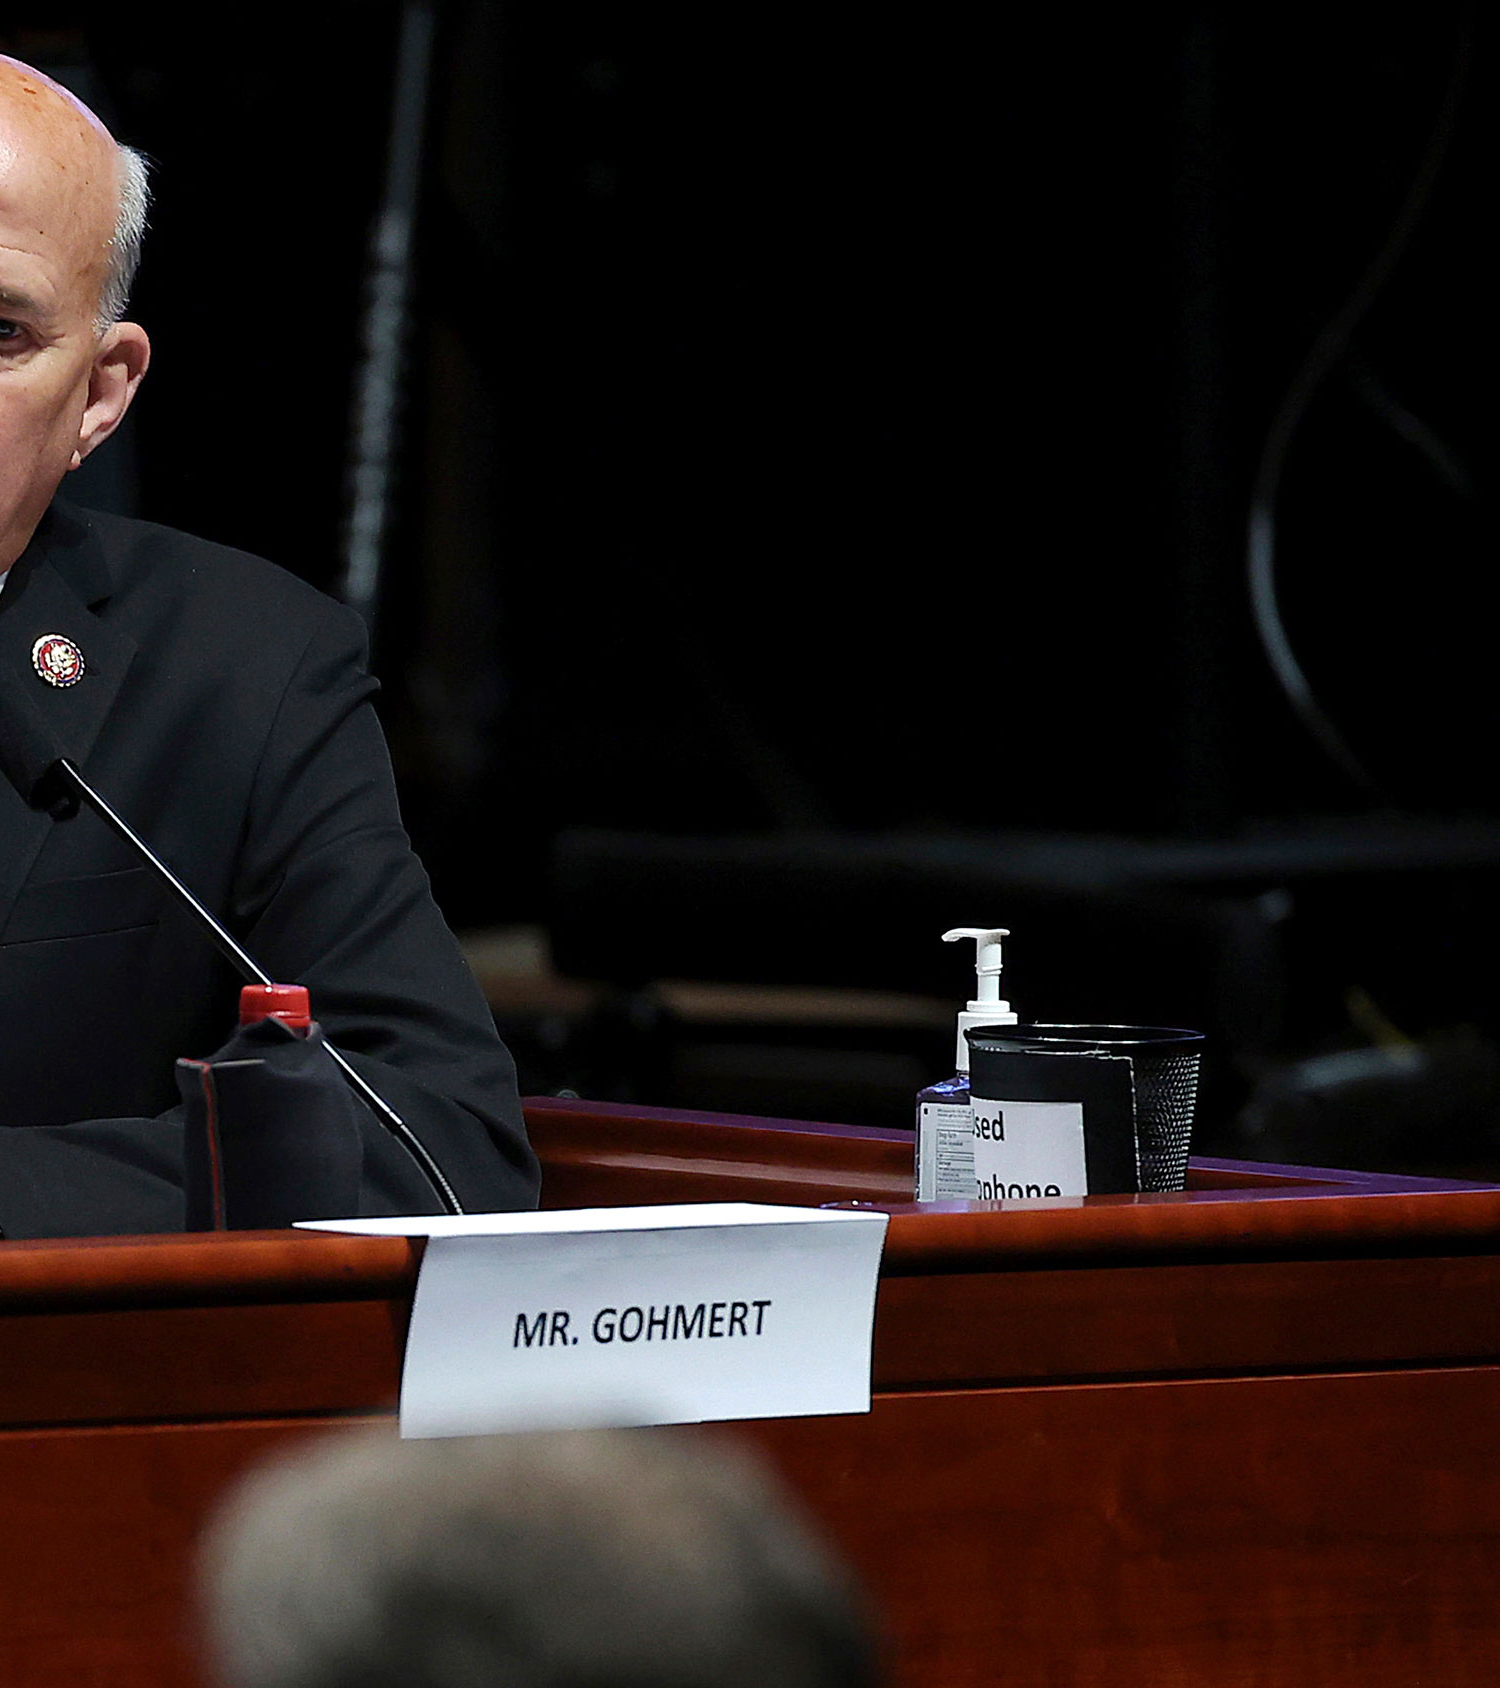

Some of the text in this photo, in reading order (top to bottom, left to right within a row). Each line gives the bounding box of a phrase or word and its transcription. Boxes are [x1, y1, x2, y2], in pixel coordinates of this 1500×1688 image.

[971, 1110, 1005, 1142] sed
[513, 1300, 772, 1349] MR. GOHMERT
